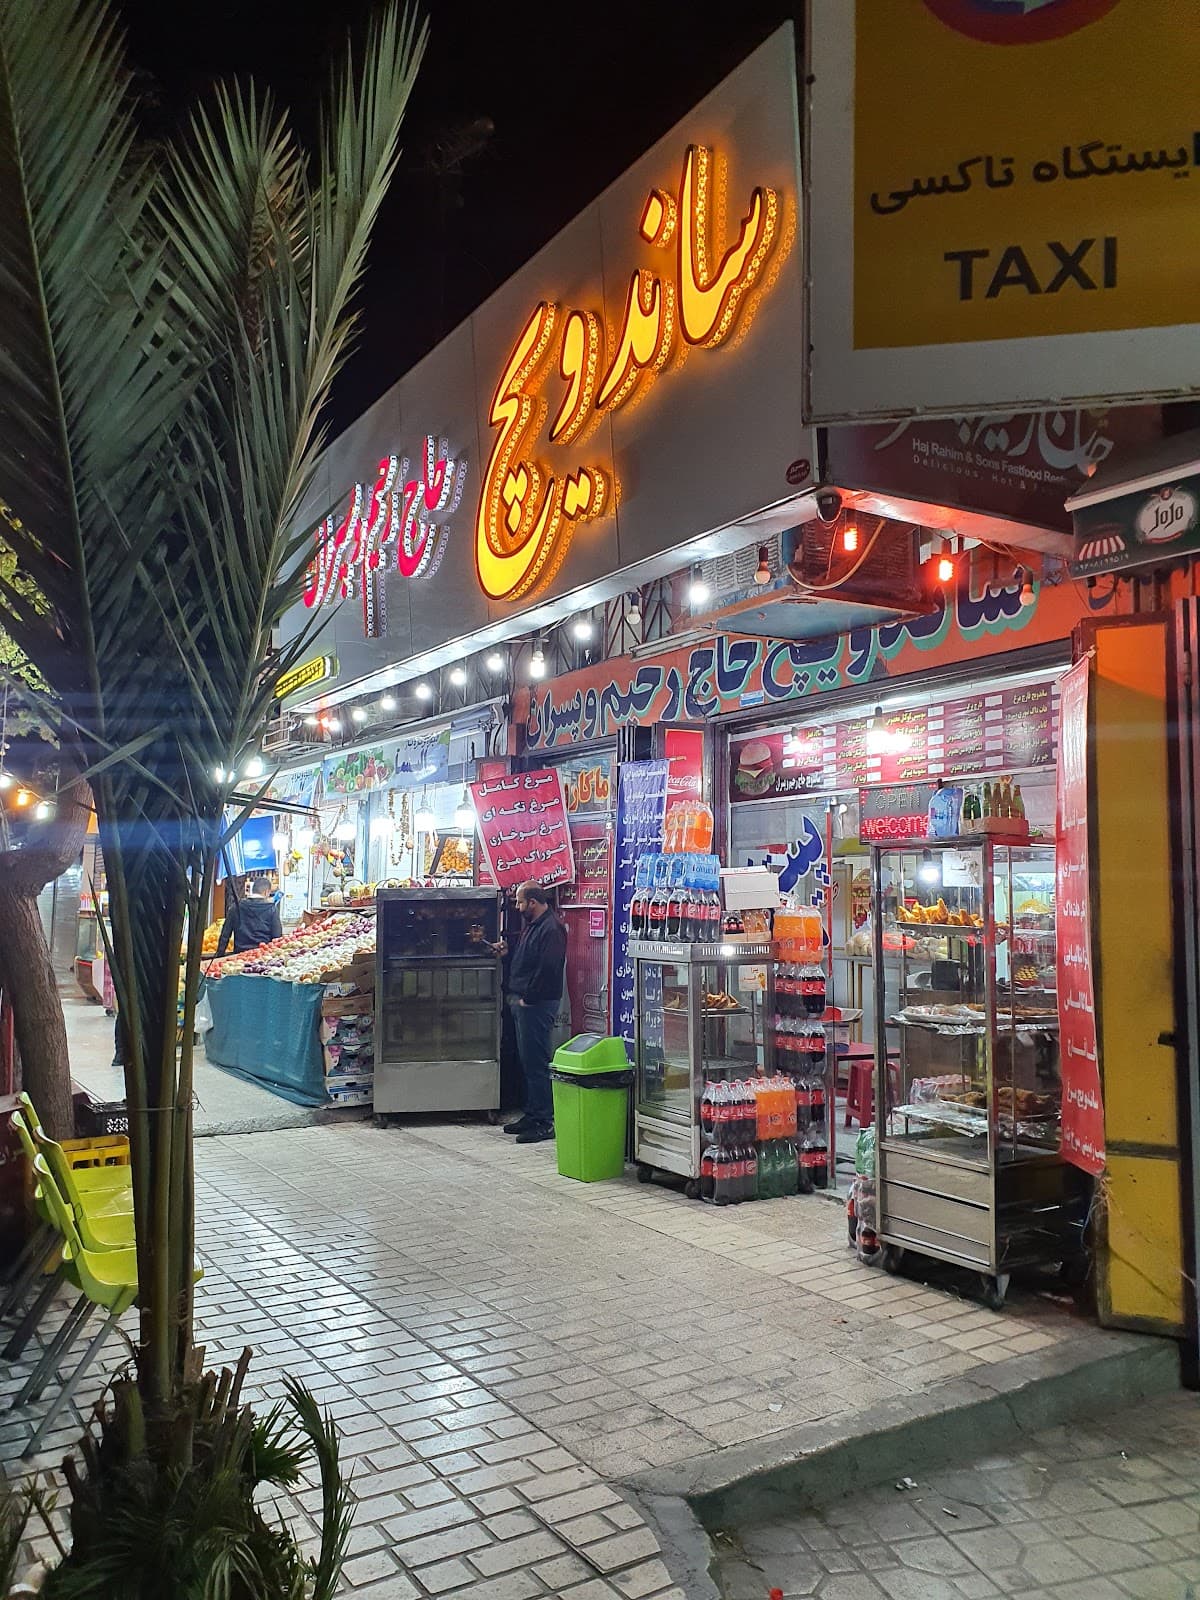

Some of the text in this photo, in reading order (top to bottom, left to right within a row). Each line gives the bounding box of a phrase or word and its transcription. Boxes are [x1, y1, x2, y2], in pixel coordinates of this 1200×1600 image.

[869, 154, 1015, 216] تاکسی
[944, 236, 1118, 301] TAXI
[474, 143, 777, 601] ساندویچ
[912, 437, 931, 457] Haj
[932, 442, 964, 461] Rahim
[975, 454, 1000, 470] Sons
[600, 665, 683, 738] رحیم
[685, 636, 762, 720] حاج
[526, 687, 583, 749] پسران
[478, 772, 554, 797] مرغ کامل
[564, 766, 609, 813] ماکار
[876, 788, 921, 810] OPEN
[481, 796, 561, 822] مرغ تکه ای
[489, 819, 565, 847] مرغ سوخاری
[496, 841, 568, 871] خوراک مرغ
